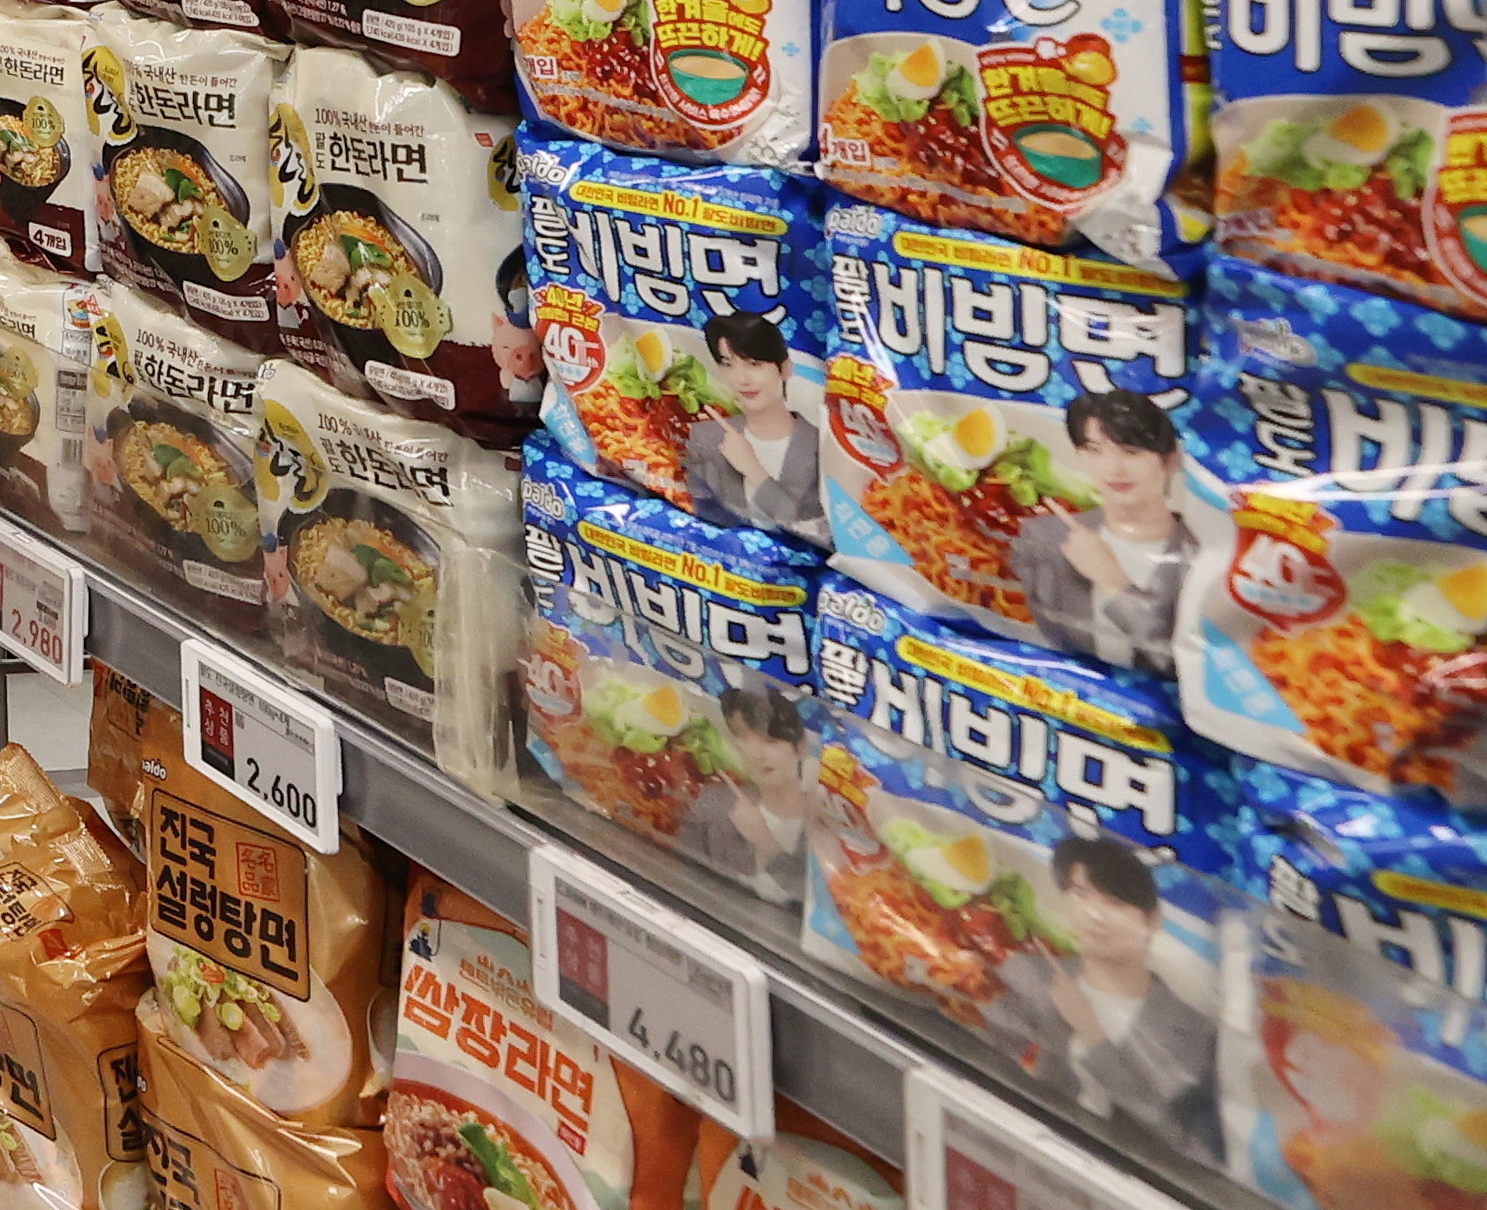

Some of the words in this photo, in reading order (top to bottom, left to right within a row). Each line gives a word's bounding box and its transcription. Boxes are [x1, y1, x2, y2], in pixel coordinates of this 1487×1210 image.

[654, 21, 766, 62] 뜨끈하게!
[4, 57, 64, 86] 한돈라면
[144, 64, 176, 82] 국내산
[135, 80, 238, 129] 한돈라면
[315, 108, 340, 126] 100%
[328, 131, 427, 184] 한돈라면
[516, 149, 568, 186] paldo
[663, 192, 698, 219] No.1
[827, 205, 882, 238] paldo
[33, 228, 67, 252] 4개입
[531, 195, 571, 276] 팔도
[568, 209, 787, 325] 비빔면
[832, 256, 868, 344] 팔도
[872, 261, 1190, 410] 비빔면
[522, 478, 564, 518] paldo
[681, 554, 719, 588] No.1
[10, 609, 64, 665] 2,980
[565, 540, 813, 703] 비빔면
[817, 590, 887, 635] paldo
[247, 758, 317, 829] 2,600
[159, 805, 216, 882] 진국
[157, 870, 303, 982] 설렁탕면
[401, 968, 595, 1137] 쌈장라면
[630, 1007, 739, 1105] 4,480
